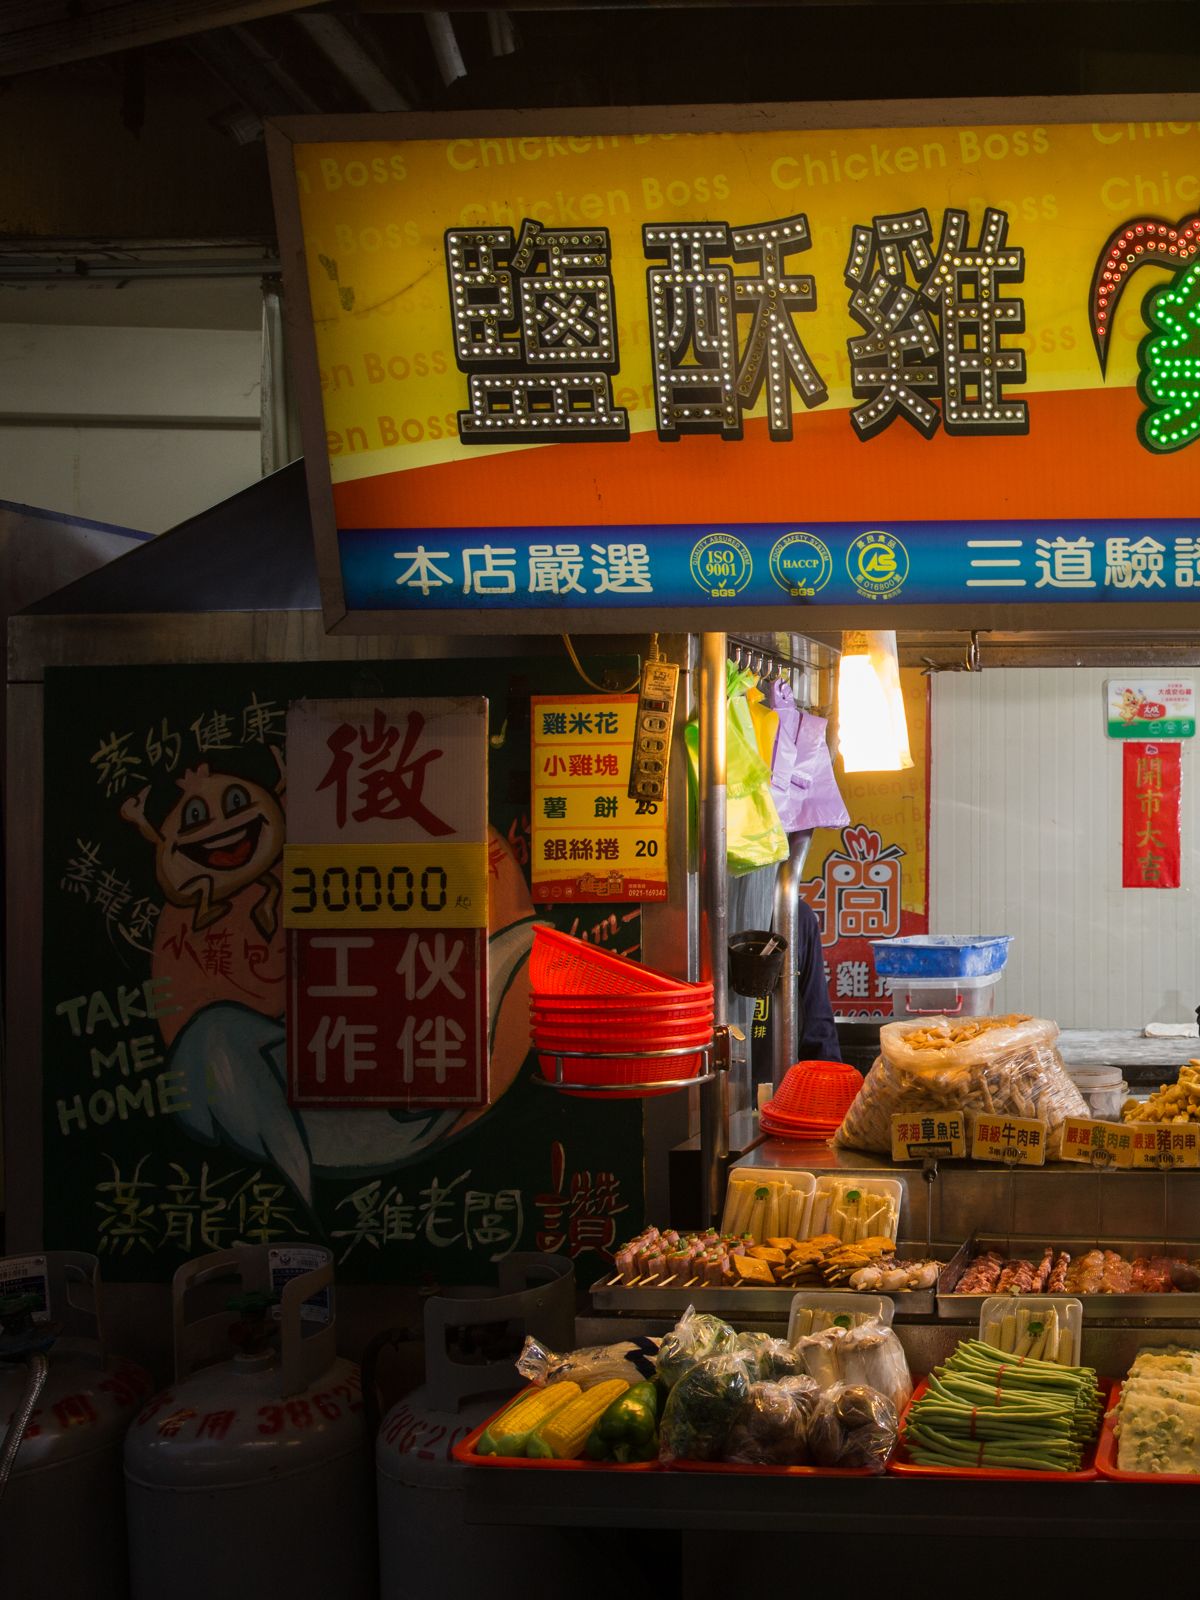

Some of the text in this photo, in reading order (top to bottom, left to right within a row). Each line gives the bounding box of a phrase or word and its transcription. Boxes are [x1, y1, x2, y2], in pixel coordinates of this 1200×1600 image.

[319, 153, 408, 192] Boss
[770, 139, 947, 191] Chicken
[960, 127, 1050, 165] Boss
[640, 174, 732, 212] Boss
[445, 207, 1030, 444] 鹽酥雞
[363, 349, 449, 386] Boss
[378, 412, 460, 448] Boss
[393, 544, 654, 596] 本店嚴選
[706, 563, 737, 577] 9001
[707, 550, 735, 564] ISO
[783, 559, 820, 569] HACCP
[710, 588, 737, 598] SGS
[790, 587, 816, 597] SGS
[543, 712, 619, 735] 雞米花
[316, 708, 457, 837] 徵
[543, 754, 619, 777] 小雞塊
[1136, 757, 1166, 881] 開市大吉
[543, 838, 658, 861] 銀絲捲 20
[291, 866, 448, 914] 30000
[55, 976, 184, 1037] TAKE
[89, 1034, 165, 1080] ME
[897, 1118, 961, 1142] 深海章魚足
[977, 1122, 1041, 1148] 頂級牛肉串
[1066, 1125, 1131, 1150] 嚴選雞肉串
[1133, 1128, 1197, 1152] 嚴選豬肉串
[94, 1151, 309, 1256] 蒸龍堡
[330, 1168, 525, 1267] 雞老闆
